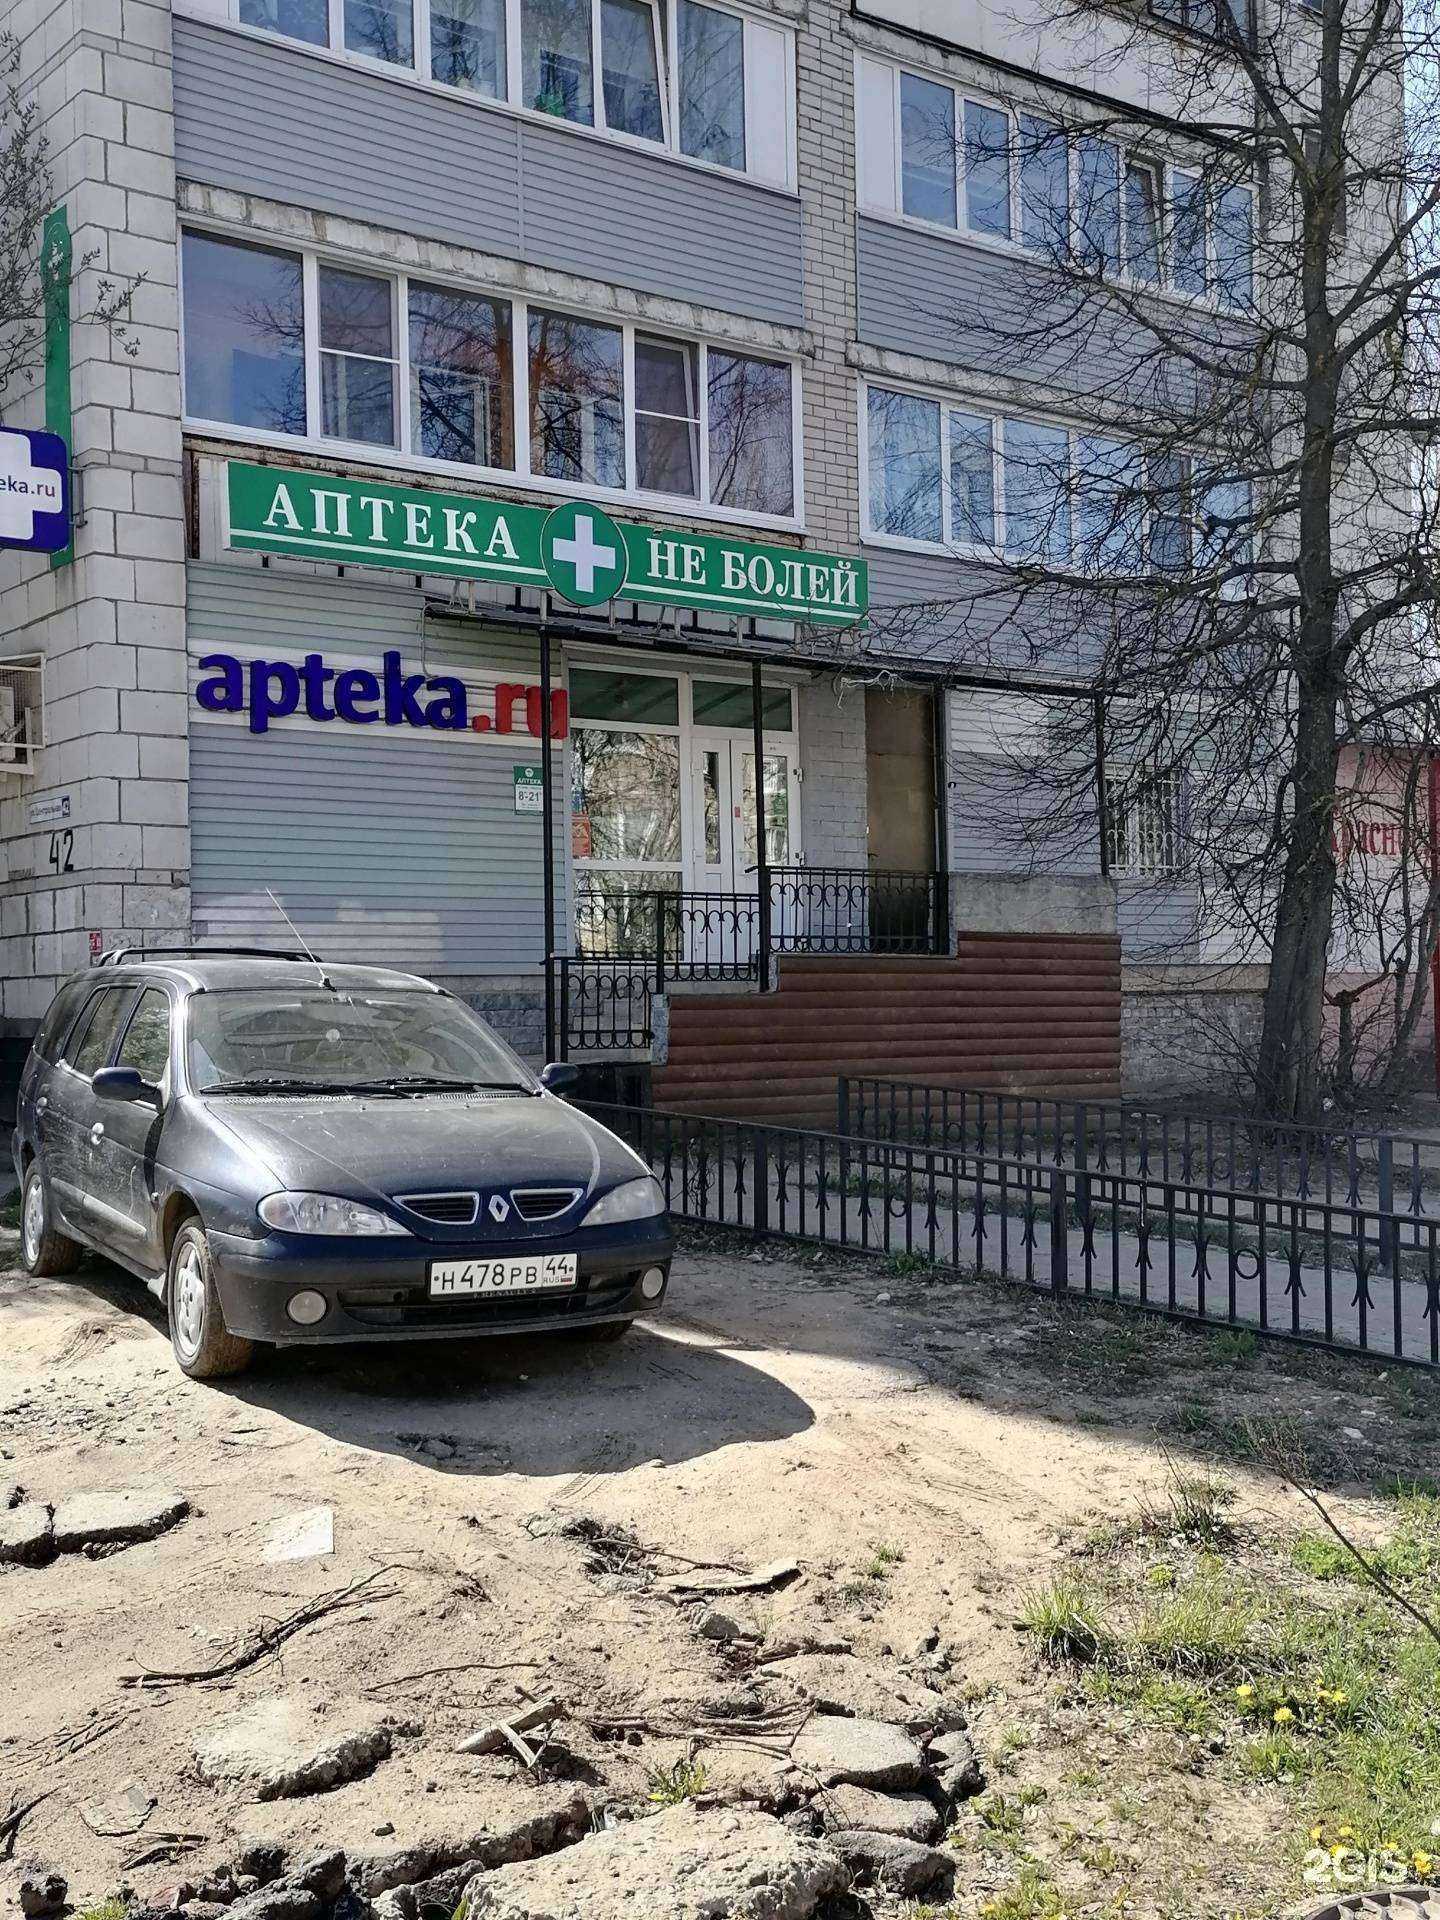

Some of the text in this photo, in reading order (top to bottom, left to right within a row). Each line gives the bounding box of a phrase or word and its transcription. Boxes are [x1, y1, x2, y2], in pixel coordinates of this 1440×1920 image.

[262, 483, 520, 560] АПТЕКА
[646, 537, 860, 607] НЕ БОЛЕЙ
[196, 651, 568, 739] apteka.ru
[50, 829, 74, 875] 42
[545, 1256, 568, 1276] 44
